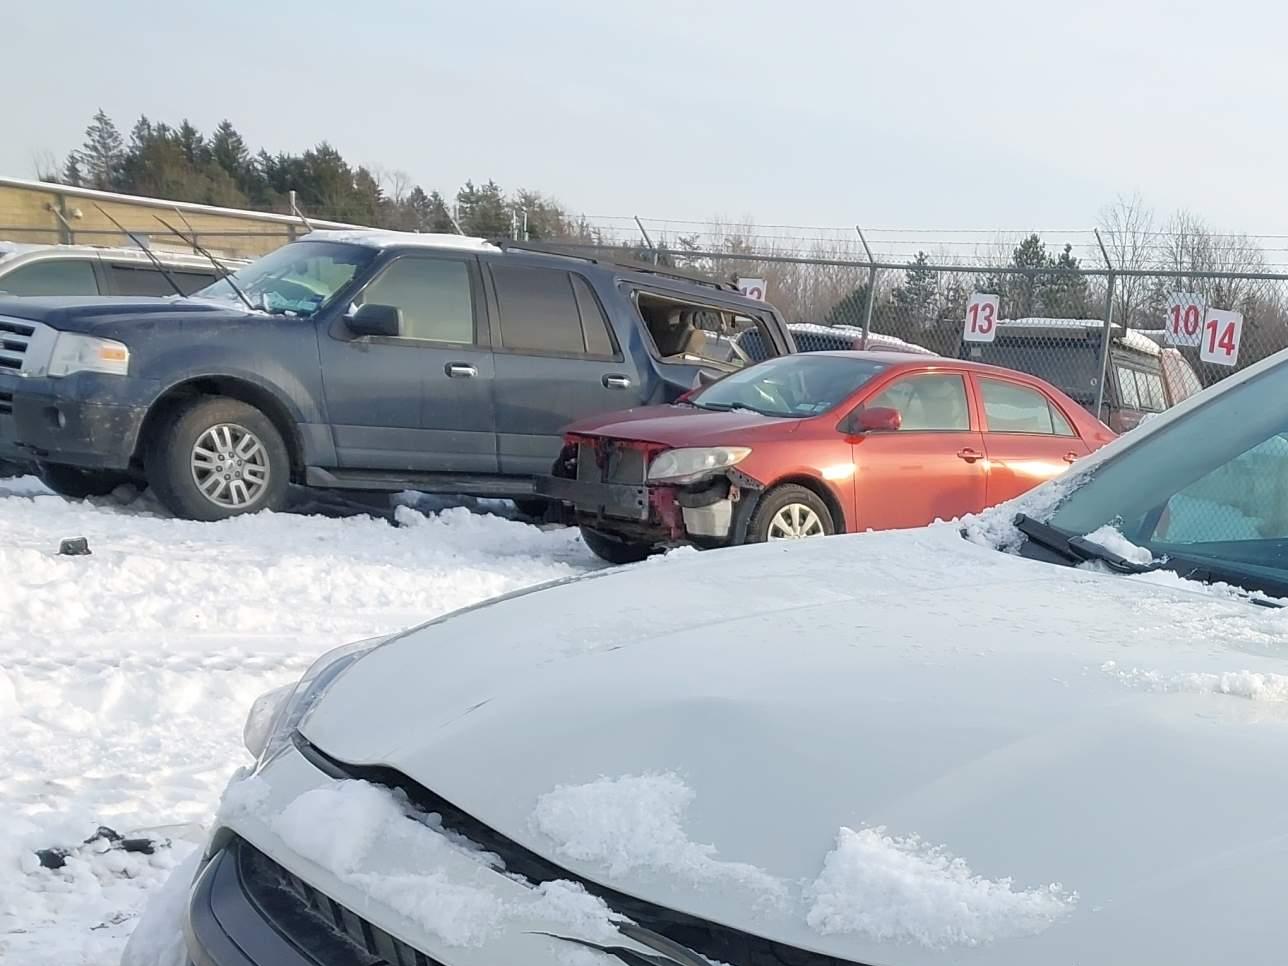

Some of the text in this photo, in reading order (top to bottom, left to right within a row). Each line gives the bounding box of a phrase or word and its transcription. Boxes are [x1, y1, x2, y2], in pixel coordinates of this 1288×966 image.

[969, 303, 994, 333] 13
[1171, 304, 1199, 335] 10
[1207, 320, 1235, 355] 14
